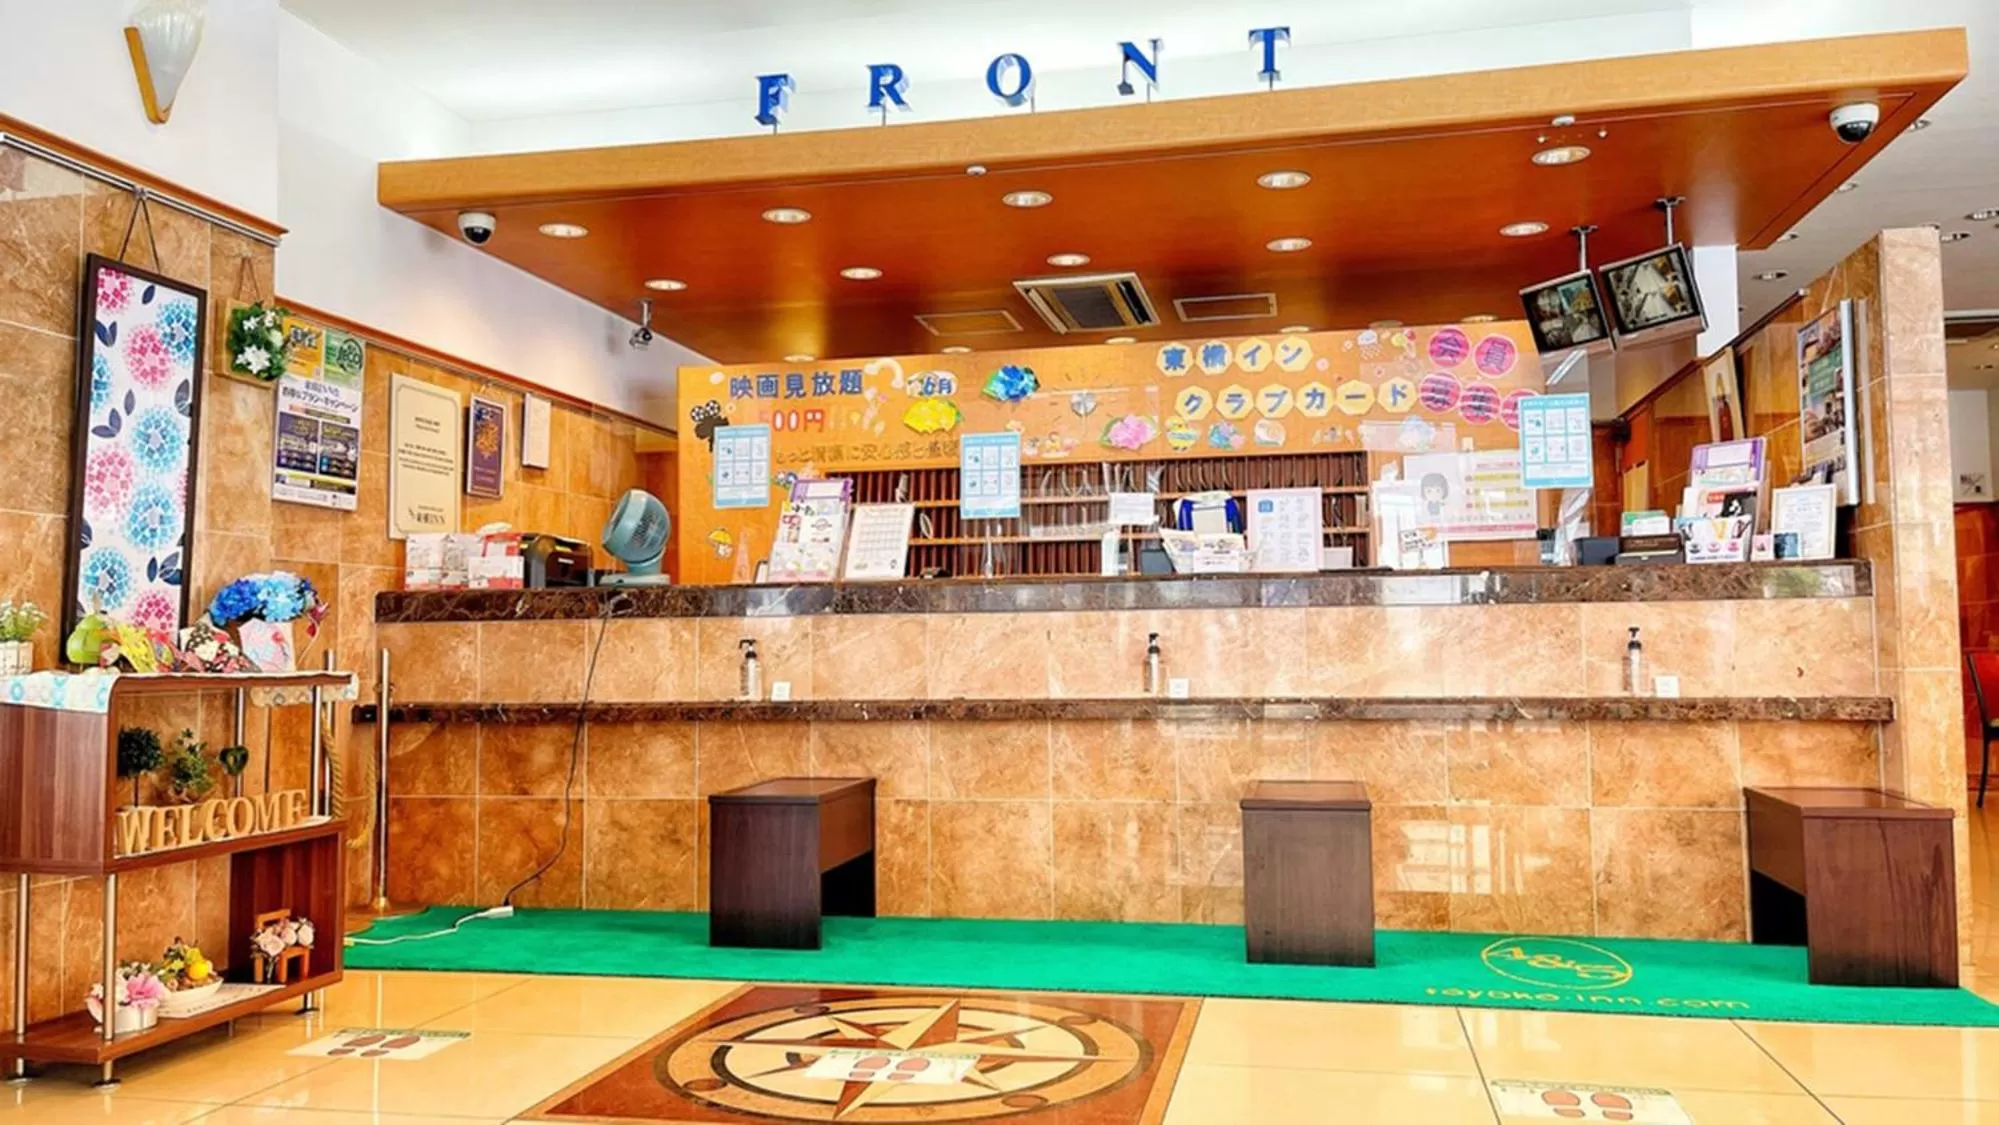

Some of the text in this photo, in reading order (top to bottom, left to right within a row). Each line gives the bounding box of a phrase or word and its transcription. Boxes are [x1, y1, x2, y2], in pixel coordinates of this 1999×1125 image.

[755, 26, 1292, 126] FRONT
[1163, 343, 1303, 368] 東横イン
[1438, 335, 1507, 372] 会員
[730, 369, 863, 400] 映画見放題
[1184, 383, 1408, 413] クラブカード
[116, 789, 306, 857] WELCOME
